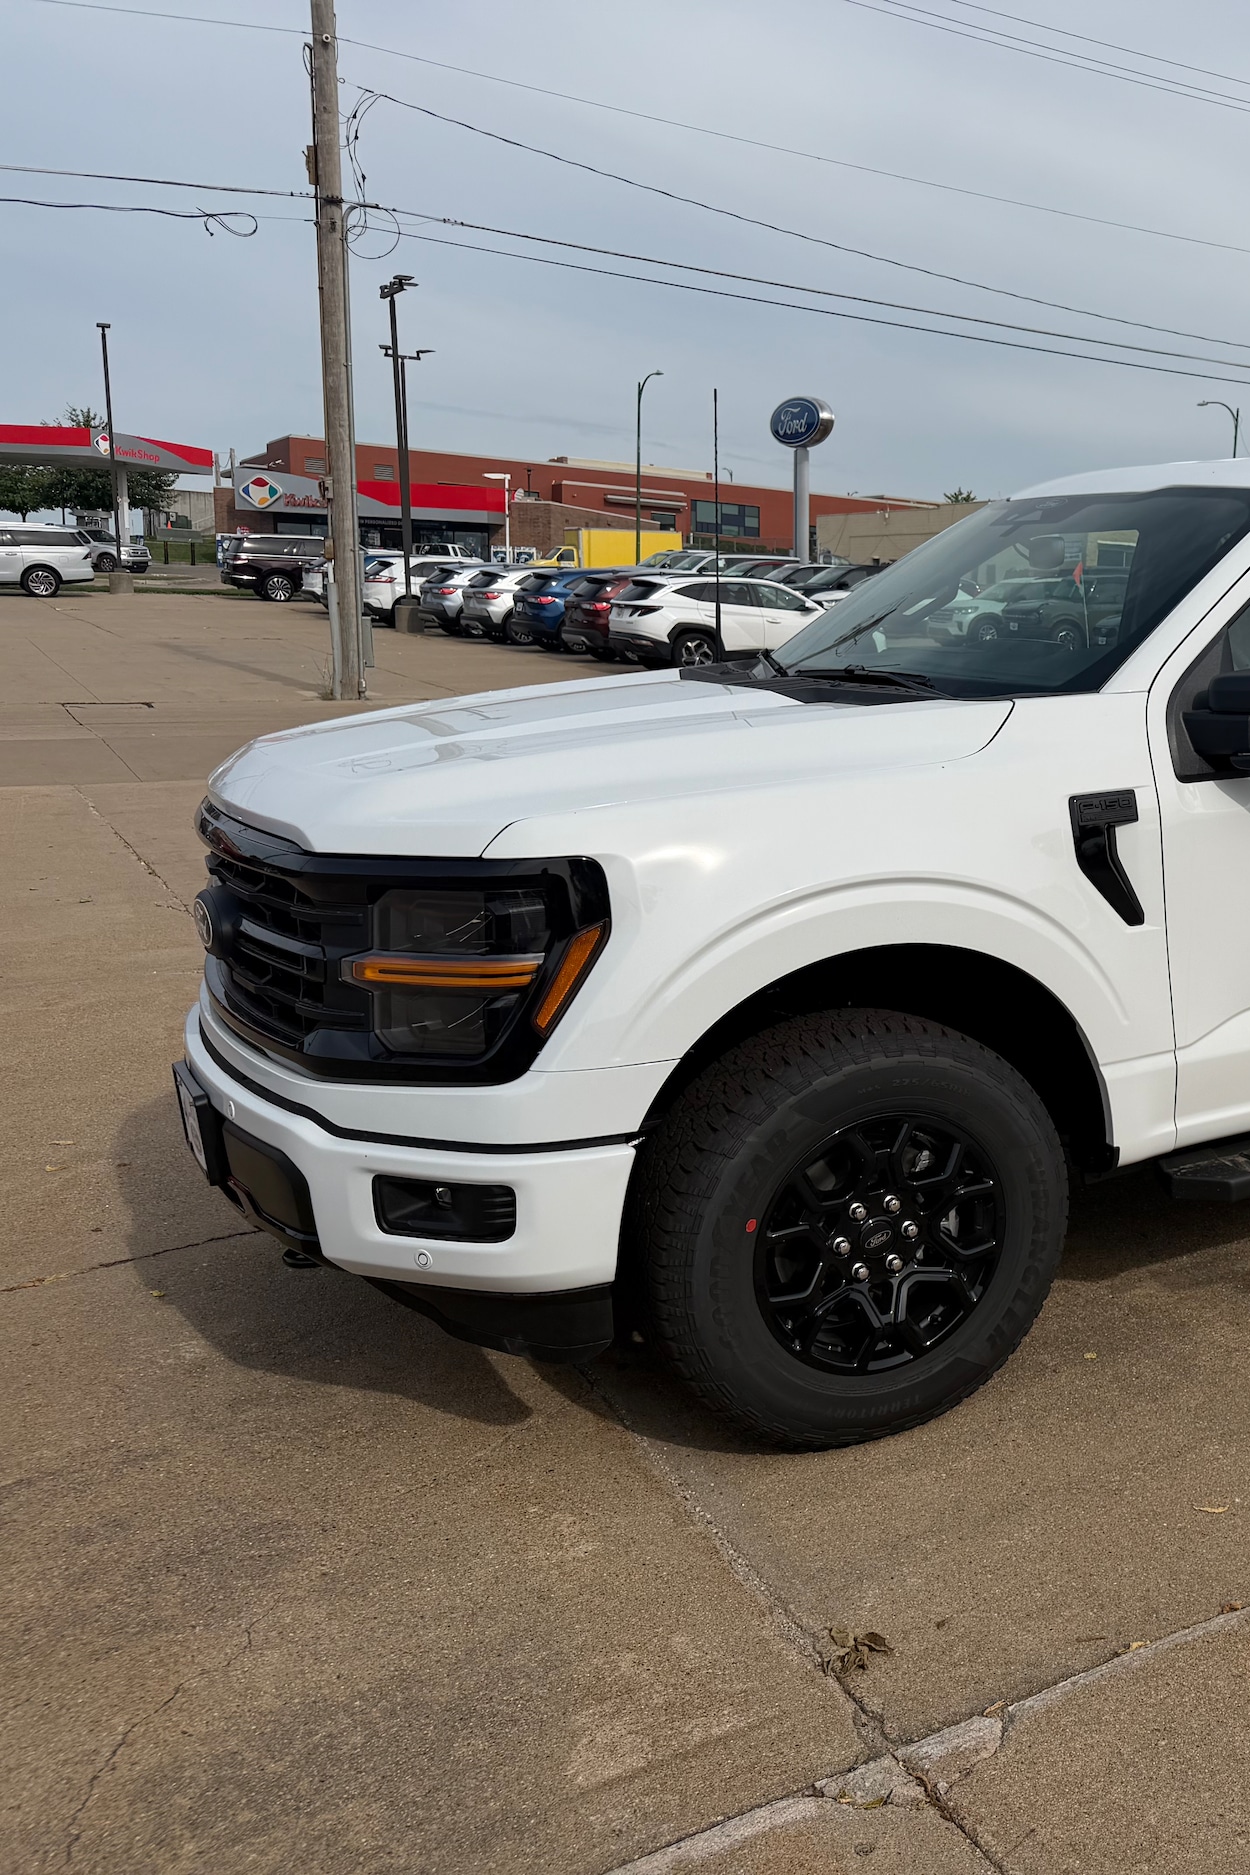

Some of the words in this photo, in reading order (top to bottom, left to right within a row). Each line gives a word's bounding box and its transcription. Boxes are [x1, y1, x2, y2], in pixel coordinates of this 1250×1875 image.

[778, 407, 809, 436] Ford
[1079, 797, 1133, 814] F-150
[870, 1233, 887, 1247] Ford
[824, 1394, 921, 1419] TERRITORY
